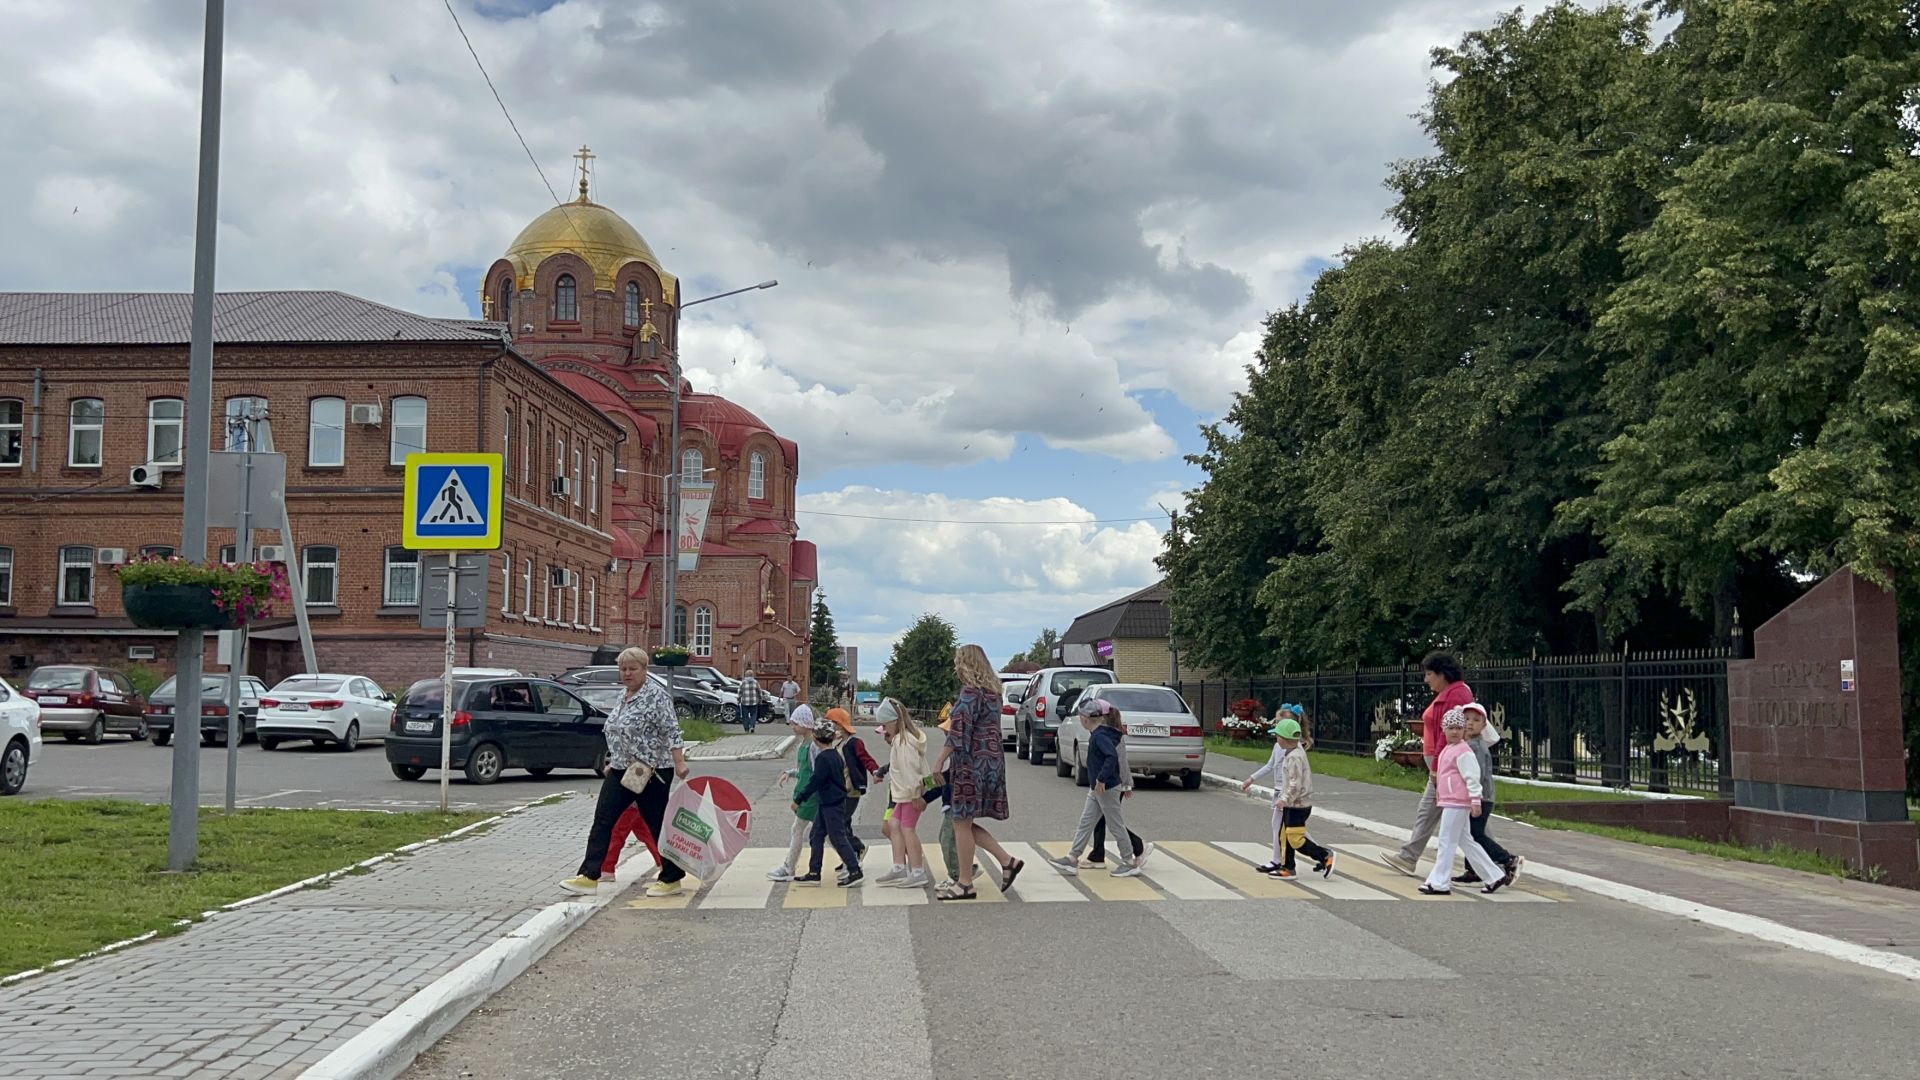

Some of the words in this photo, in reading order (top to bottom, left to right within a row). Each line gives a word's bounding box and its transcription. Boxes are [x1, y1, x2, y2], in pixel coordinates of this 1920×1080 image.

[680, 535, 692, 549] 80
[1770, 662, 1829, 688] ПАРК
[1749, 700, 1850, 728] ПОБЕДЫ
